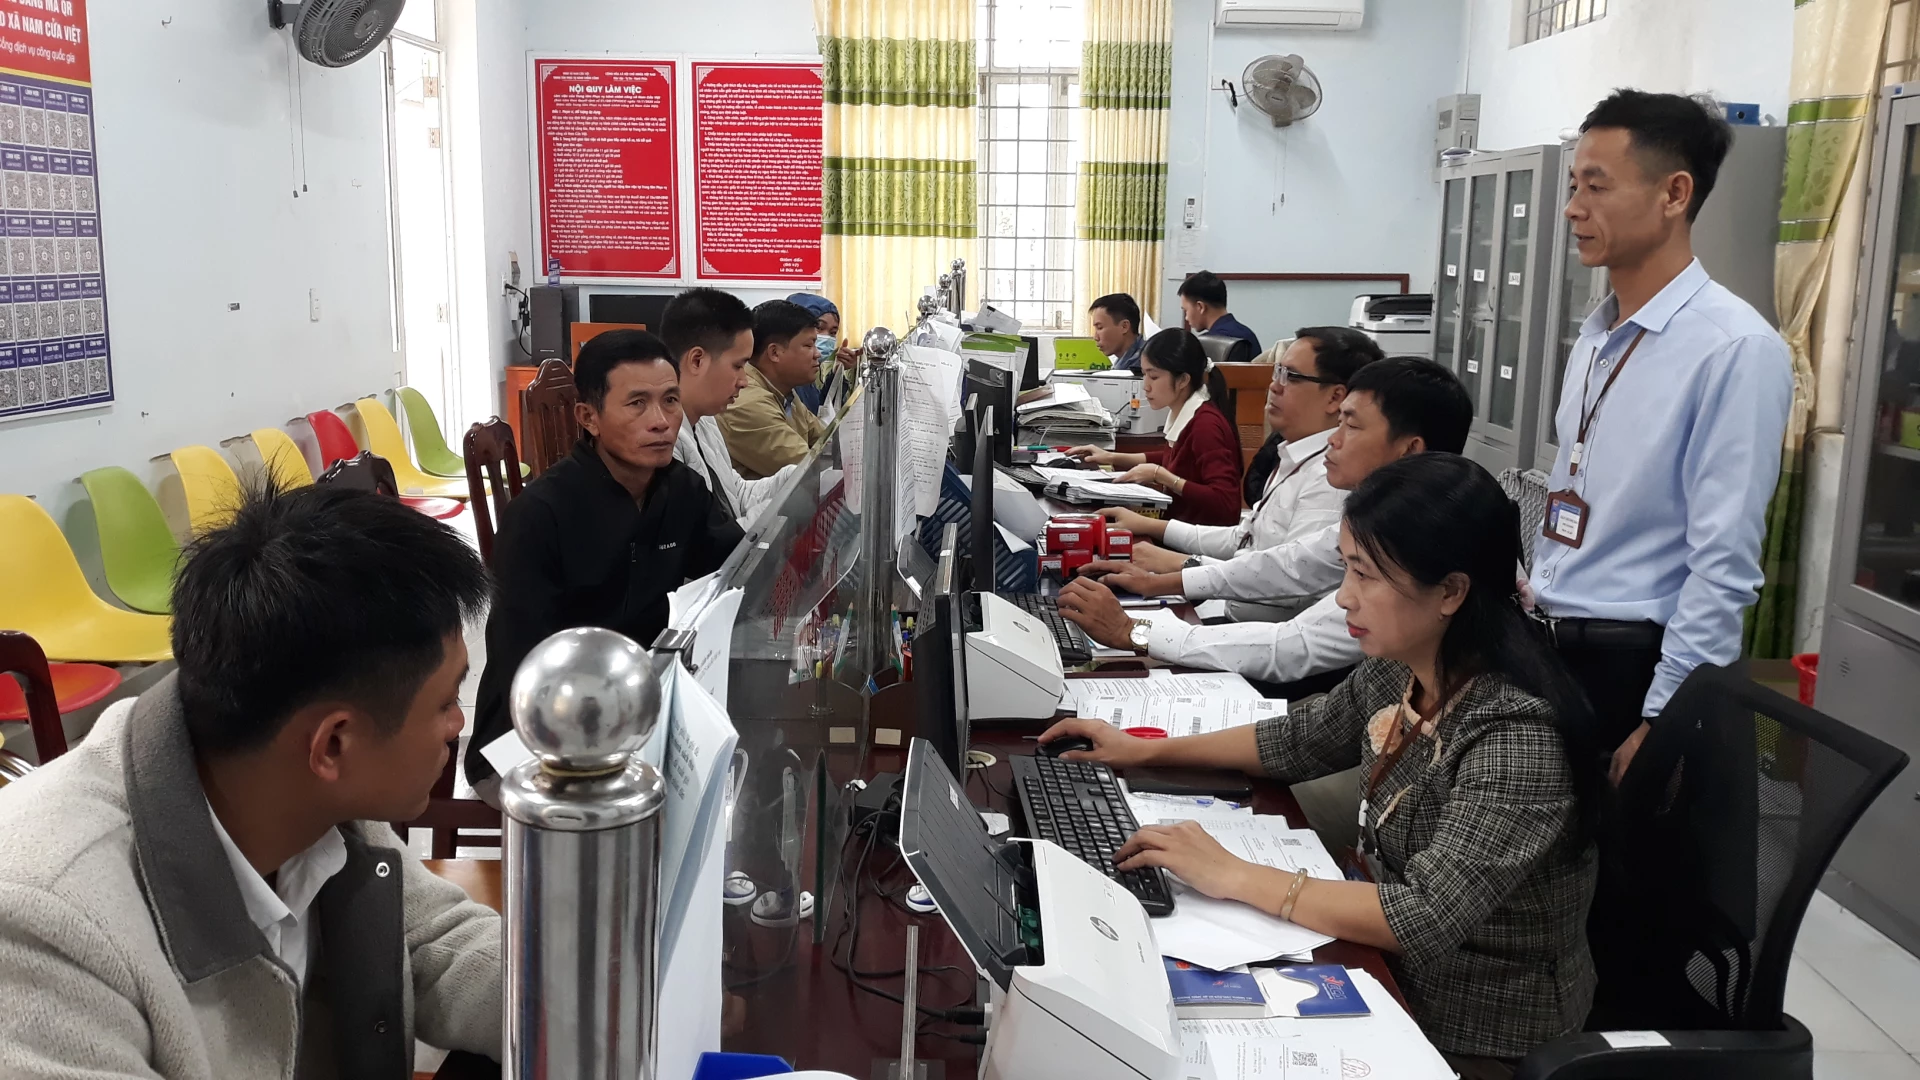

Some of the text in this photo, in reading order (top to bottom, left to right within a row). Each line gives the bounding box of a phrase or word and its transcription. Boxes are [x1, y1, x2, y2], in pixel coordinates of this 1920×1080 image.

[22, 15, 43, 35] NAM
[64, 24, 81, 46] VIỆT
[569, 84, 584, 94] NỘI
[605, 84, 621, 93] LÀM
[623, 84, 642, 95] VIỆC
